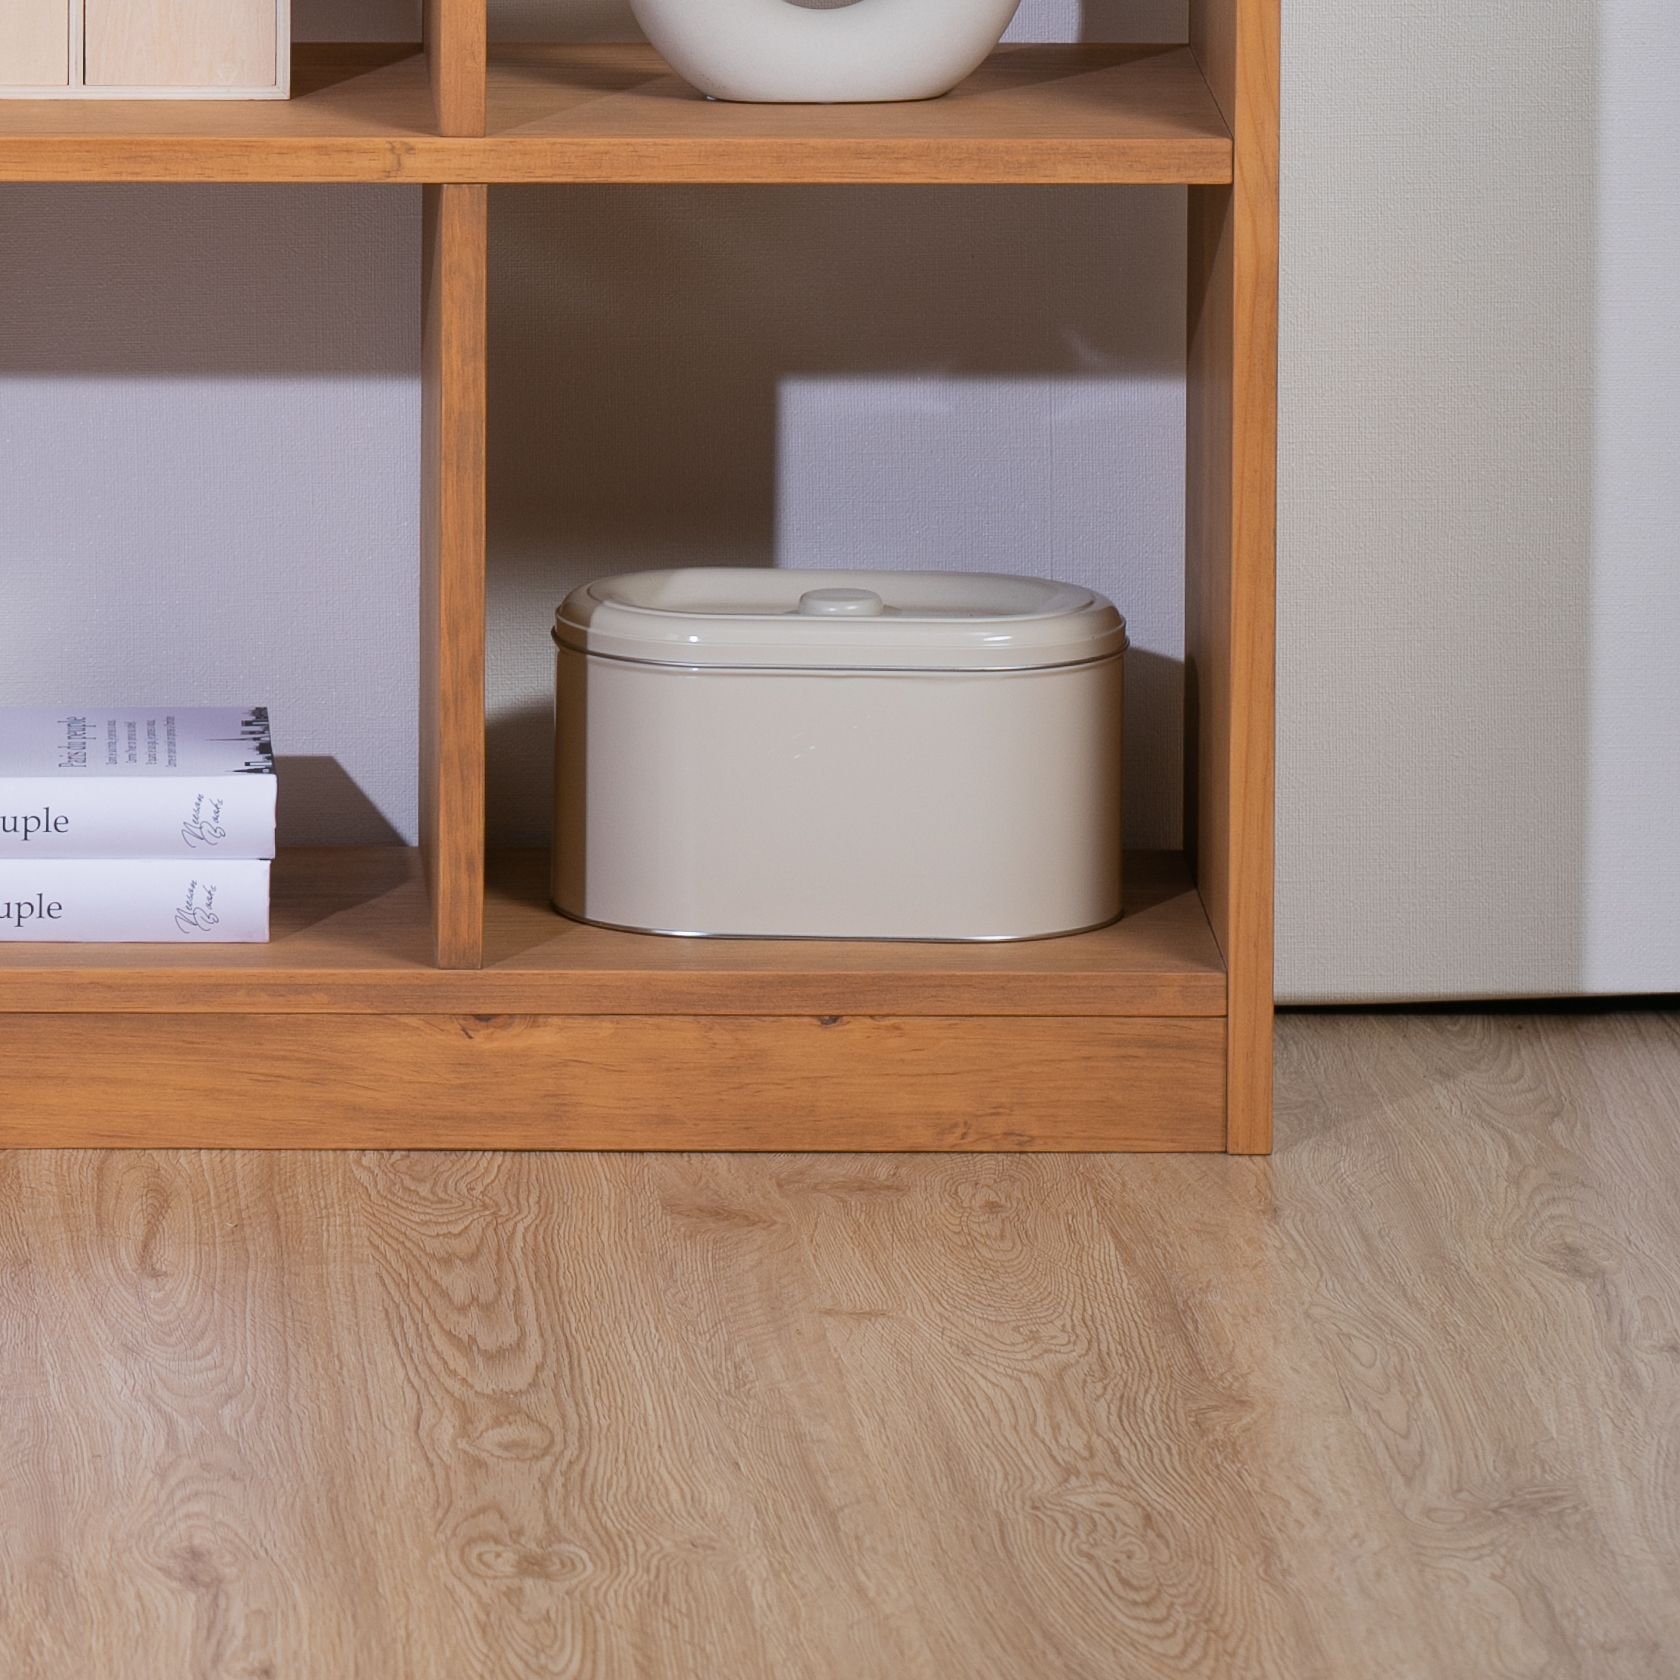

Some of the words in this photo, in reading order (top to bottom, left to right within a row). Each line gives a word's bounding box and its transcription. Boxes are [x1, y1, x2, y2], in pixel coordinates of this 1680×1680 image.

[58, 716, 97, 740] peuple
[58, 741, 87, 751] du
[58, 751, 87, 768] Paris
